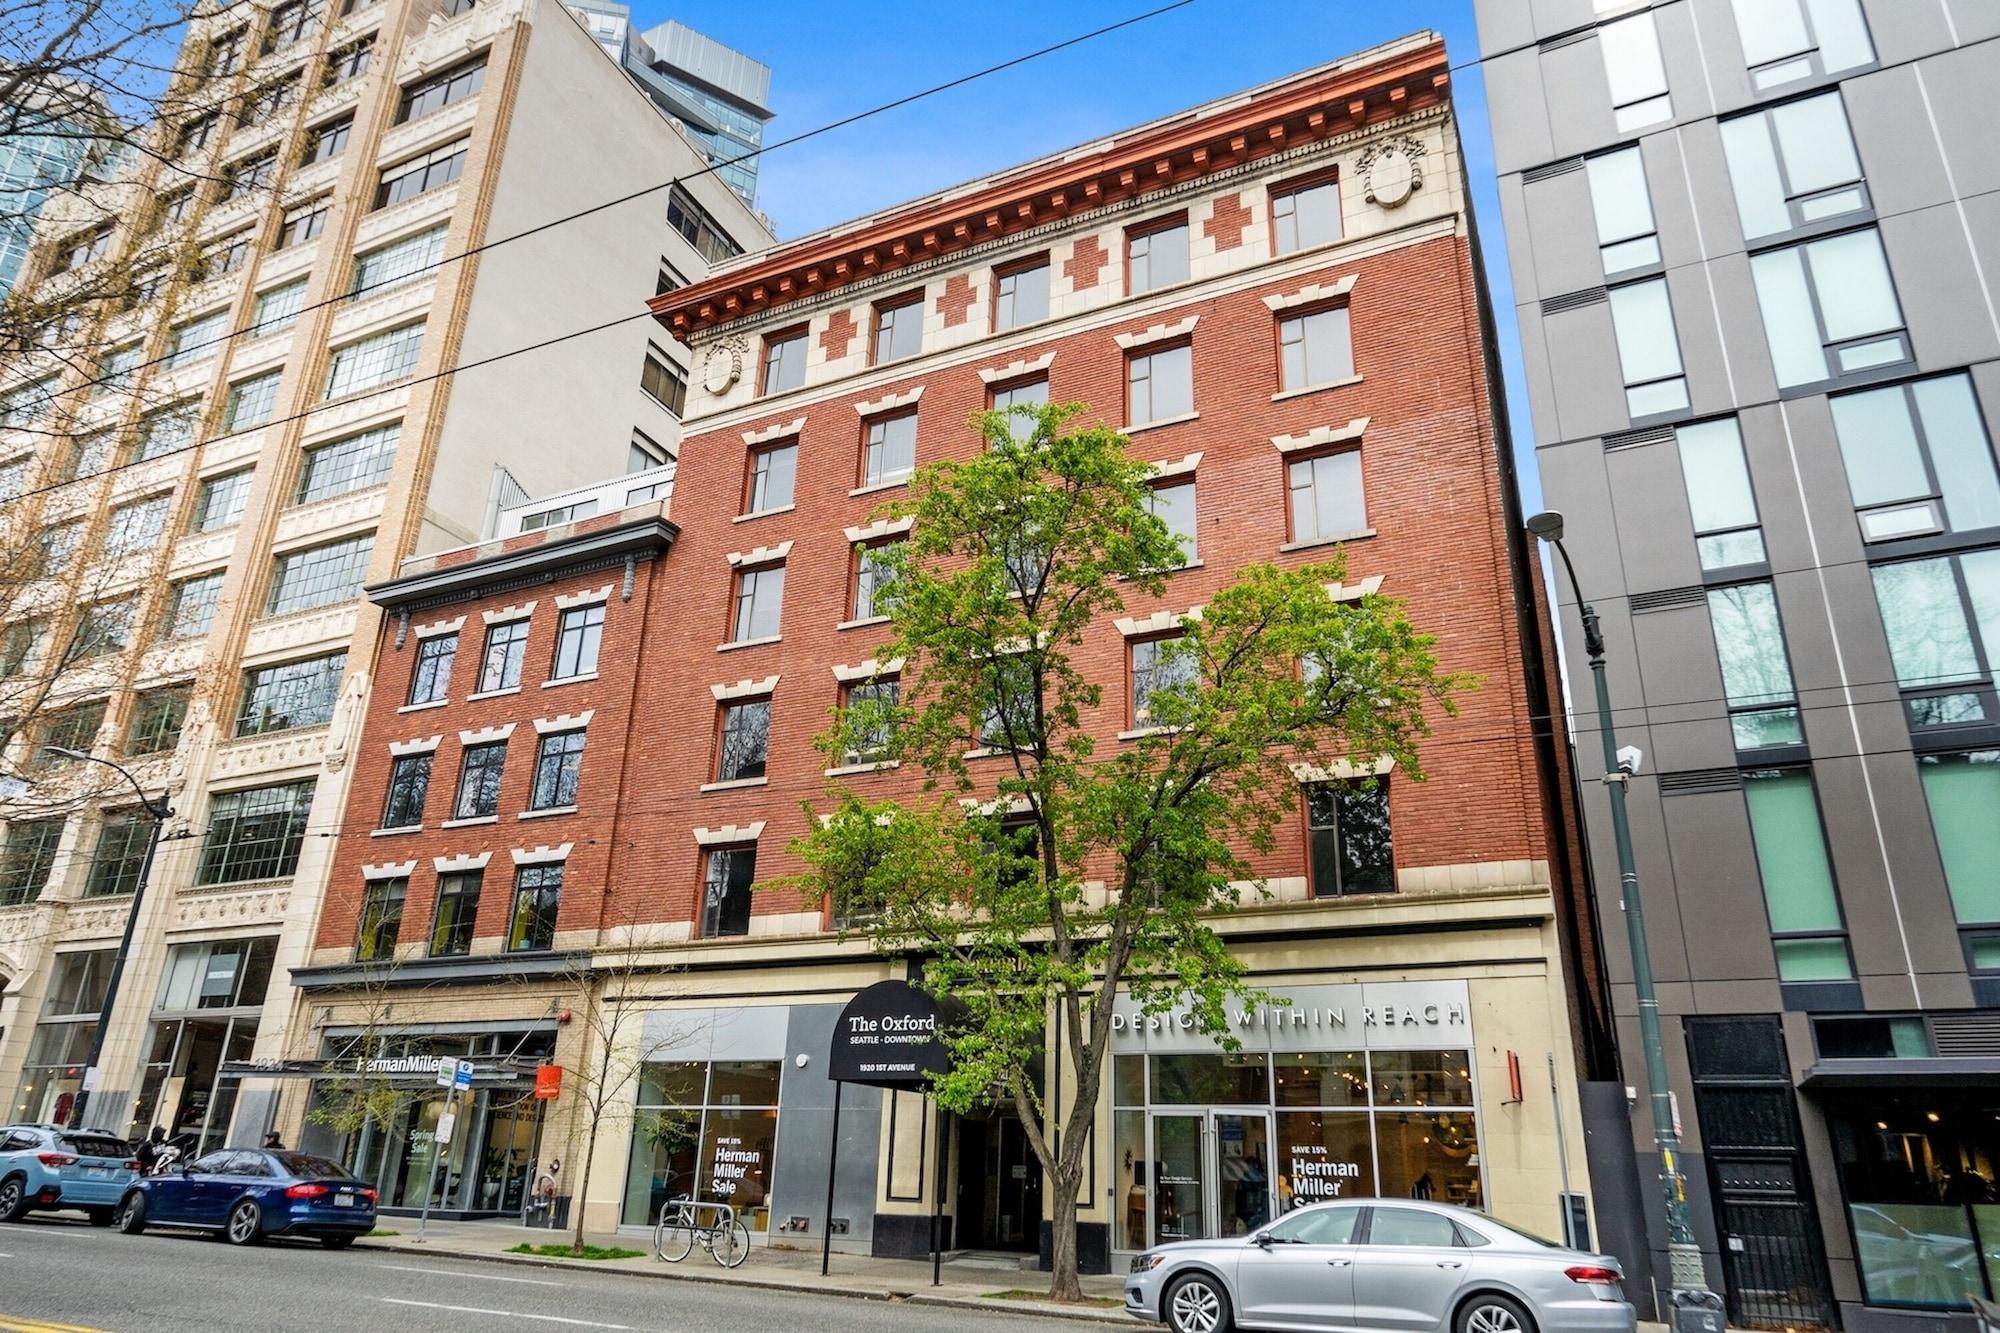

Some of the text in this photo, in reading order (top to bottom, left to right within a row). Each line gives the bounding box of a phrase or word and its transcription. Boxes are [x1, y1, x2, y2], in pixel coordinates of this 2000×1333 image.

[849, 1014, 935, 1032] The Oxford
[1111, 1002, 1465, 1030] DESIG WITHIN REACH
[850, 1036, 879, 1044] SEATTLE
[884, 1035, 931, 1044] DOWNTOWN
[357, 1055, 441, 1073] ermanMille
[860, 1064, 916, 1072] 1920 1ST AVENUE
[409, 1129, 435, 1142] Spring
[411, 1142, 428, 1154] Sale
[715, 1147, 760, 1163] Herman
[1291, 1145, 1328, 1154] SAVE 15%
[713, 1163, 748, 1179] Miller
[1291, 1158, 1359, 1177] Herman
[711, 1179, 737, 1194] Sale
[1293, 1177, 1343, 1196] Miller
